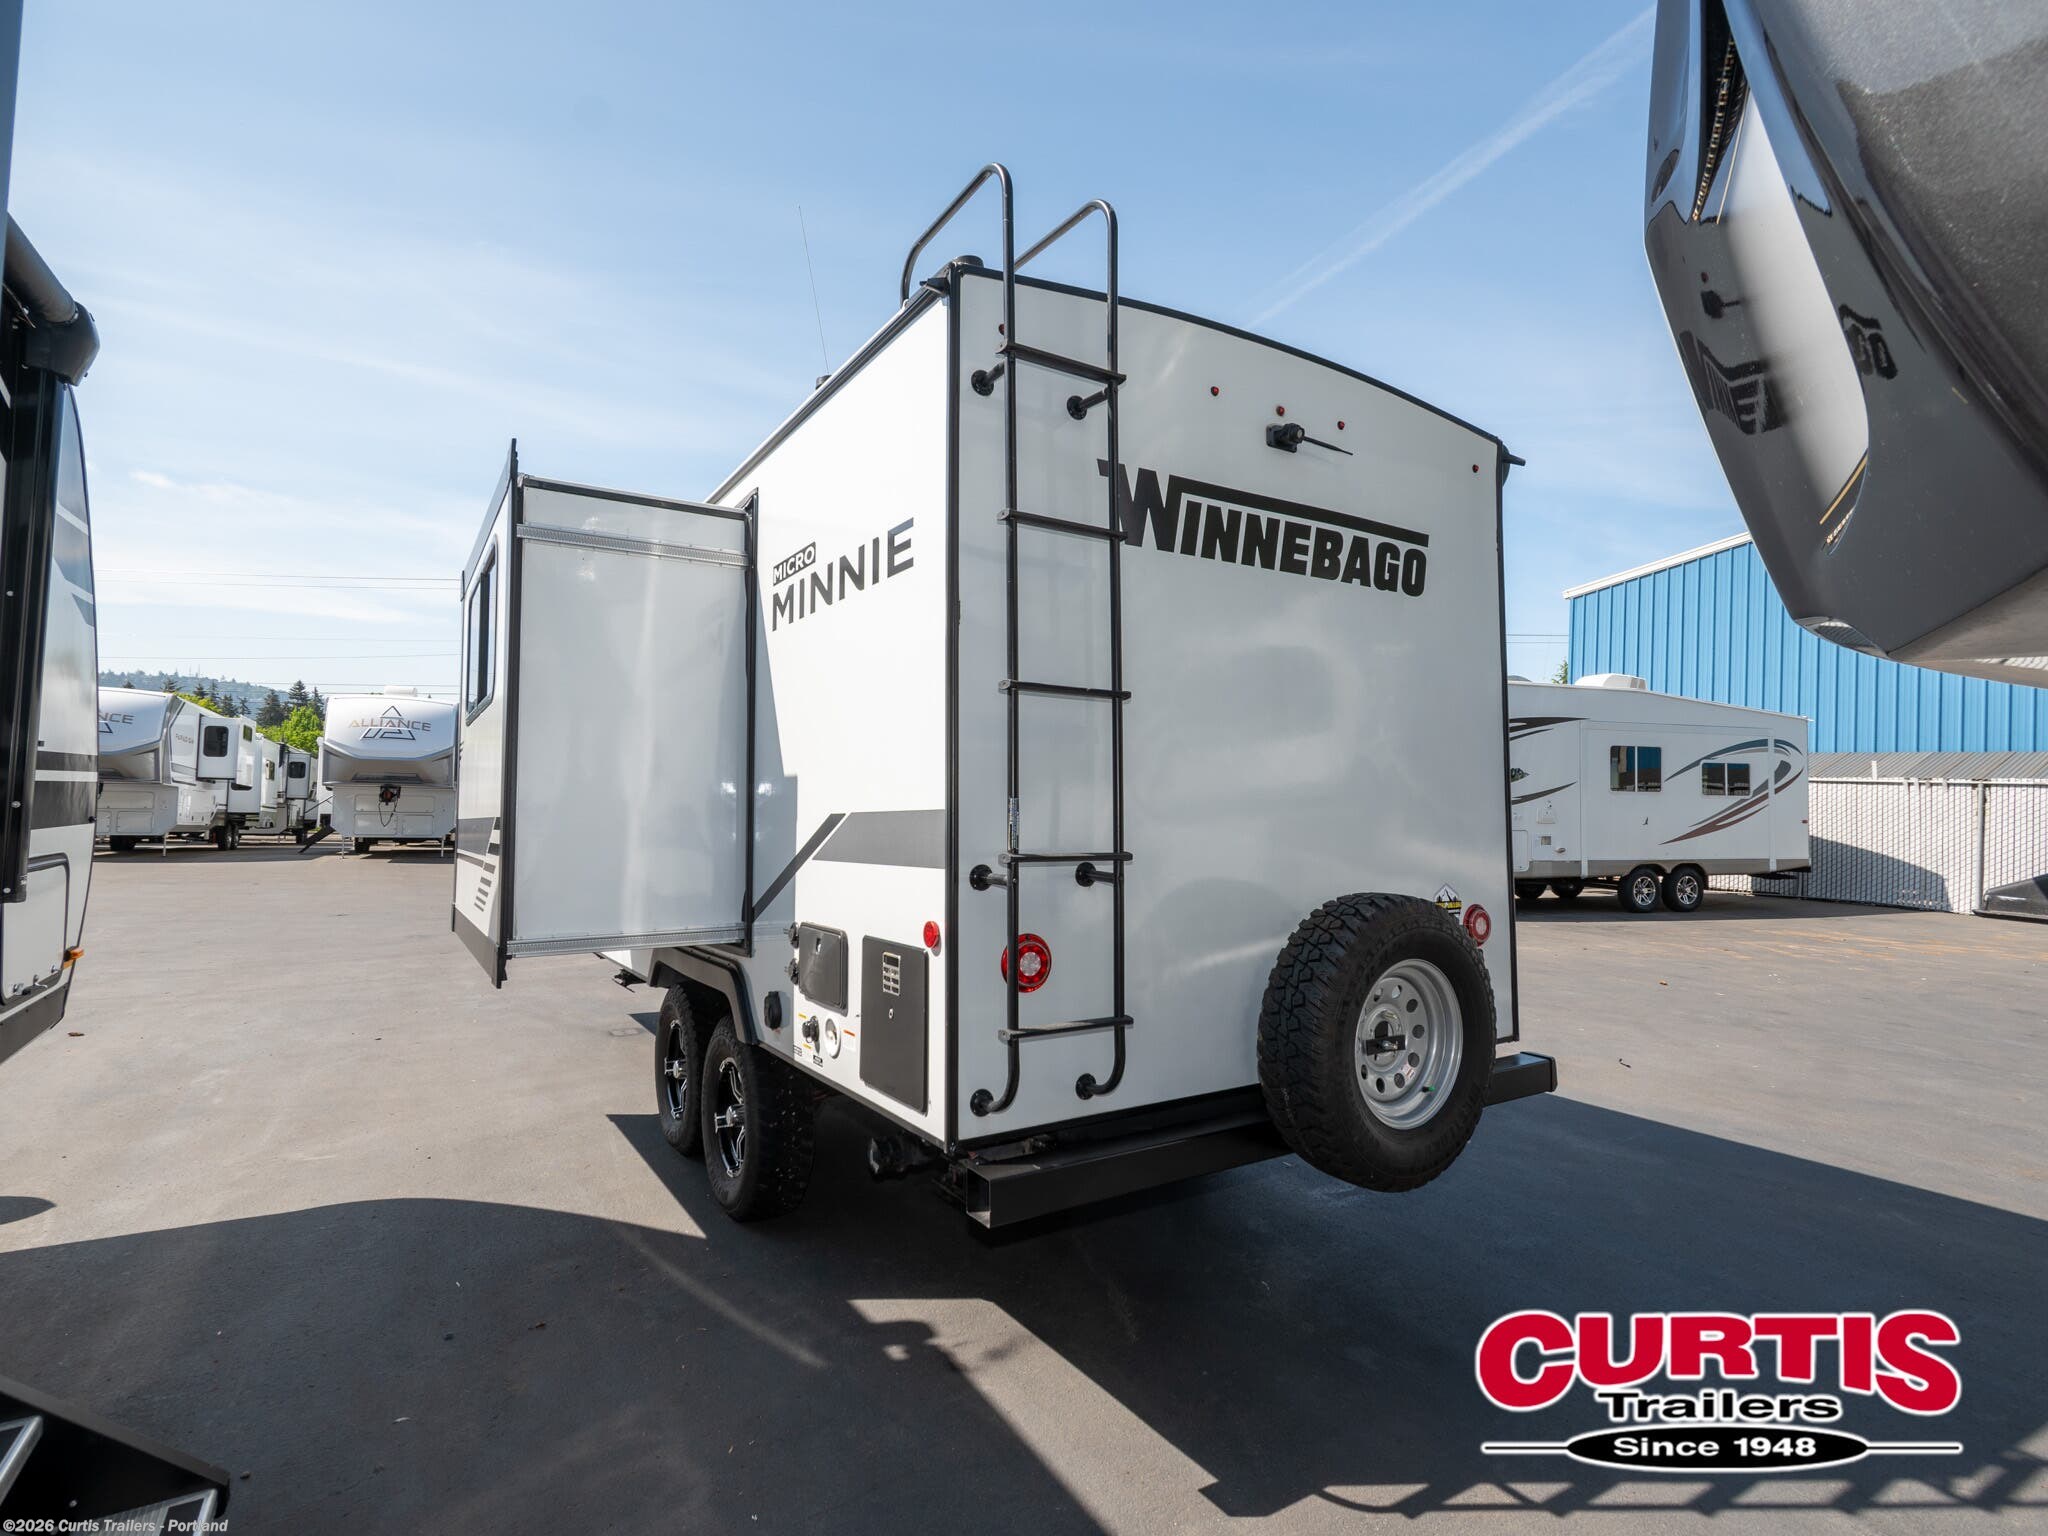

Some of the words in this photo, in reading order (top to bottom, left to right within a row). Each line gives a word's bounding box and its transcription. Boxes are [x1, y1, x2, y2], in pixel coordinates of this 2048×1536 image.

[773, 544, 816, 584] MICRO
[1097, 458, 1429, 597] WINNEBAGO
[772, 517, 914, 632] MINNIE
[348, 717, 432, 732] ALLIANCE
